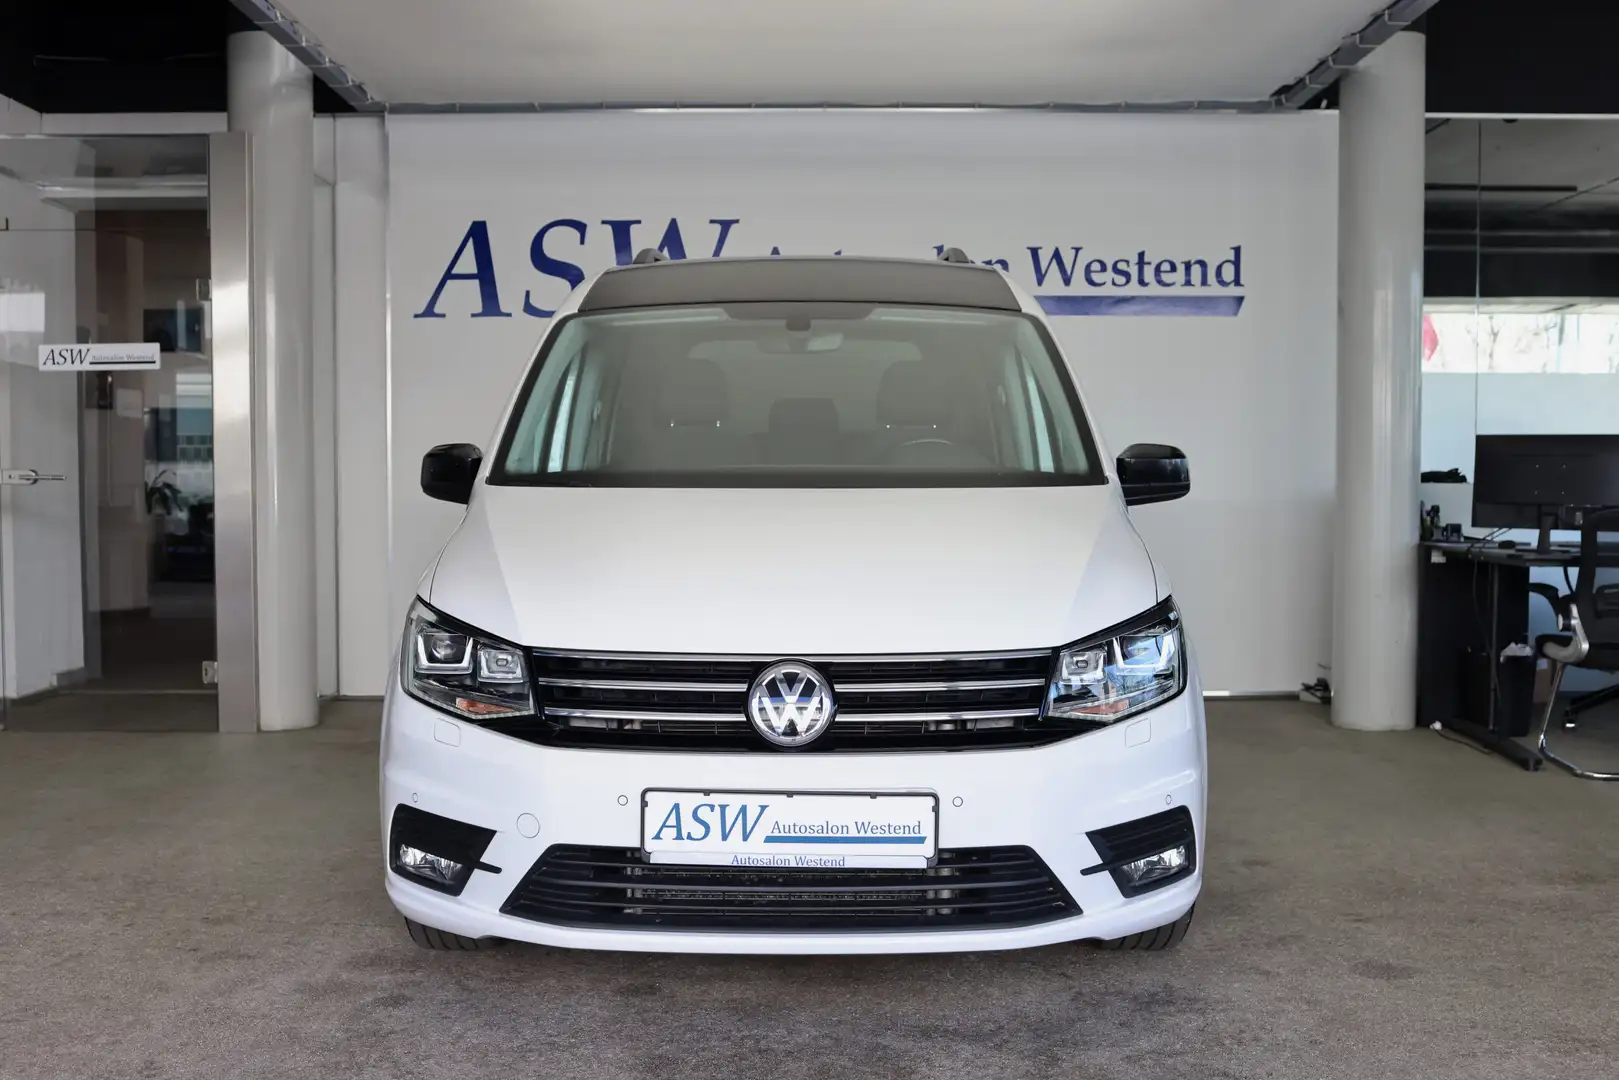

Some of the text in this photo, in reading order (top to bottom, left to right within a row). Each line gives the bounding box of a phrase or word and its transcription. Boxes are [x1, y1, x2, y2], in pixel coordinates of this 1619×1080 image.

[1027, 244, 1244, 287] Westend
[43, 348, 90, 366] ASW
[651, 802, 922, 843] ASW Autosalon Westend
[731, 854, 846, 868] Autosalon Westend
